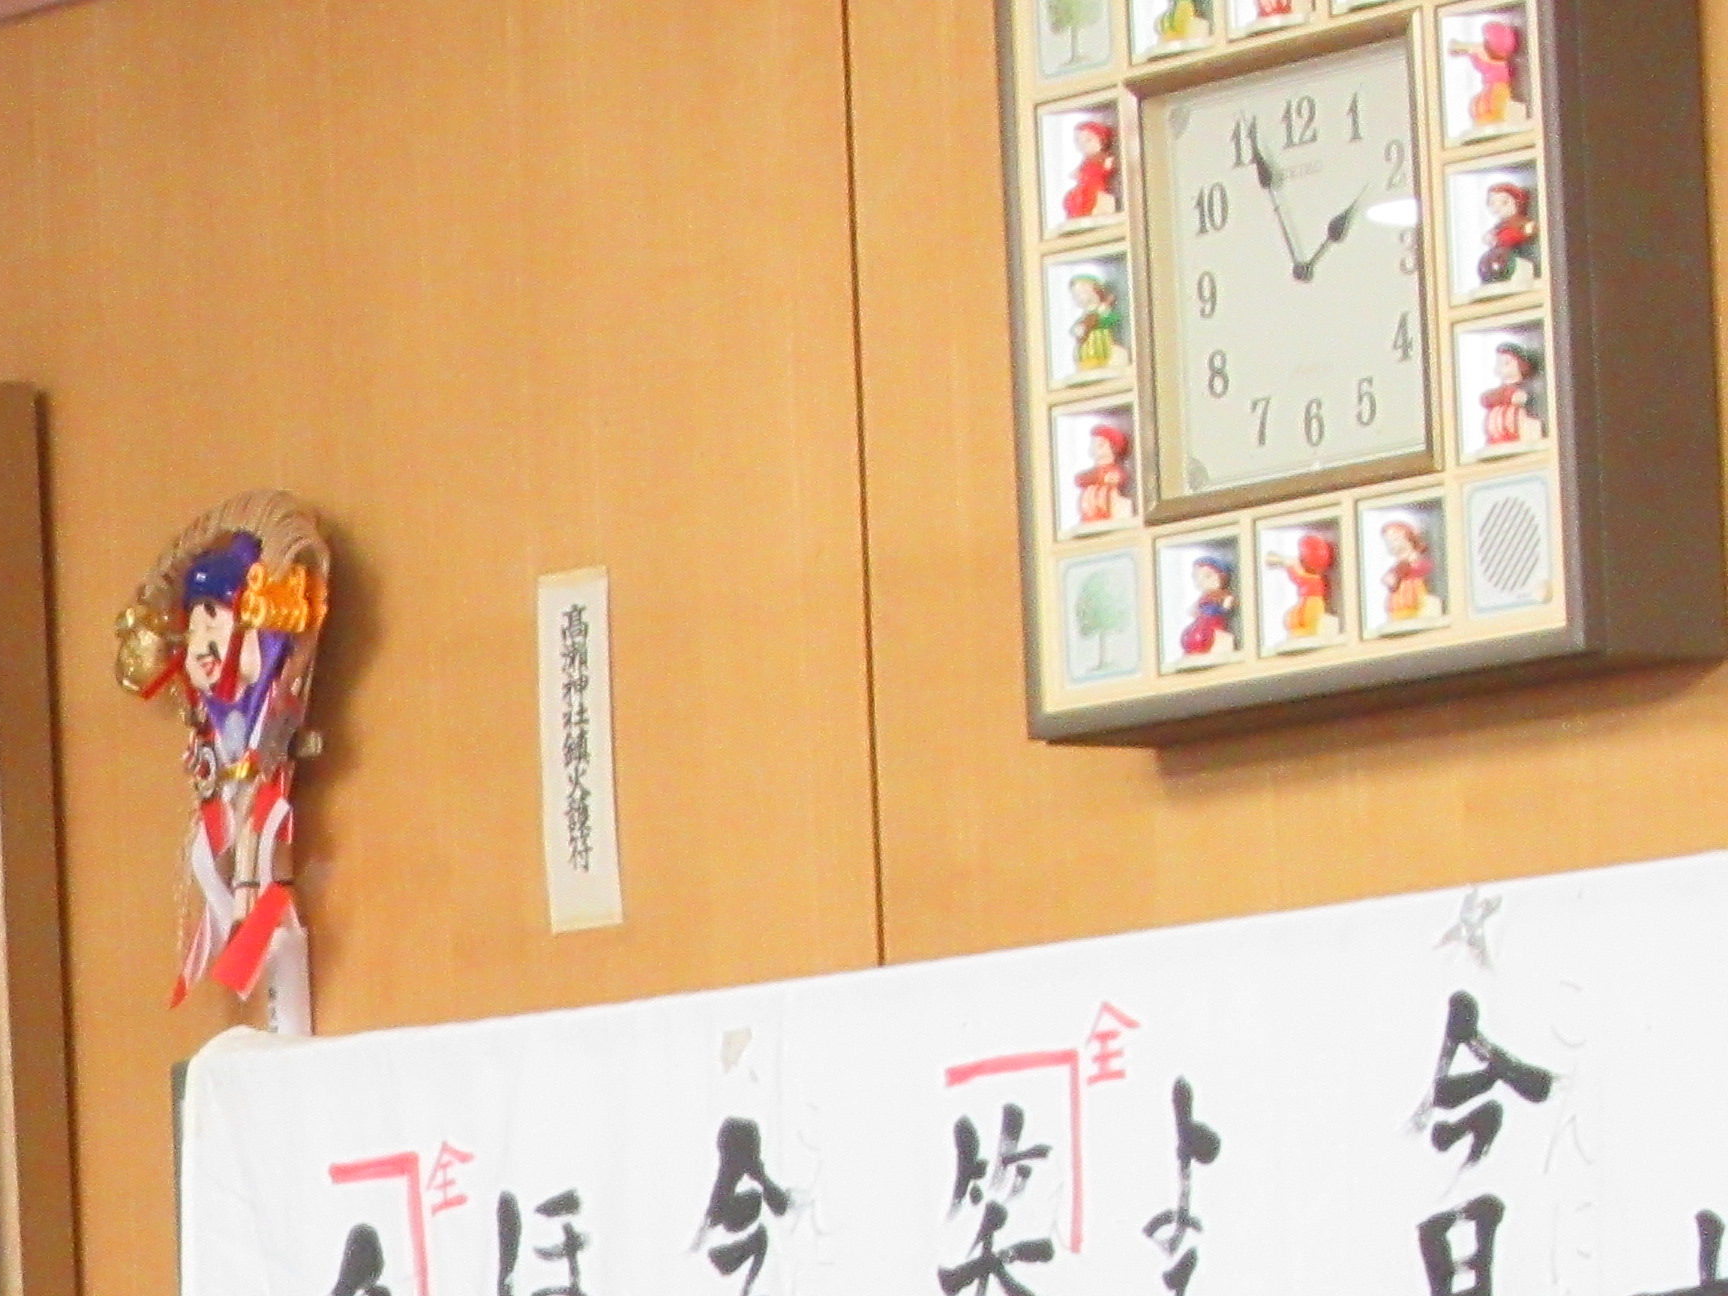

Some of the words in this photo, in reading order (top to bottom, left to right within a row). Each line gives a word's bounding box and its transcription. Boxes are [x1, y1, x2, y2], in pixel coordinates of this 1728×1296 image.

[1229, 114, 1260, 169] 11
[1282, 95, 1318, 150] 12
[1346, 92, 1362, 143] 1
[1384, 138, 1406, 192] 2
[1193, 181, 1229, 237] 10
[1196, 270, 1217, 319] 9
[1392, 312, 1414, 363] 4
[1206, 350, 1230, 399] 8
[1250, 396, 1272, 448] 7
[1303, 398, 1326, 448] 6
[1356, 376, 1378, 427] 5
[1085, 1000, 1142, 1087] 全
[425, 1140, 474, 1216] 全
